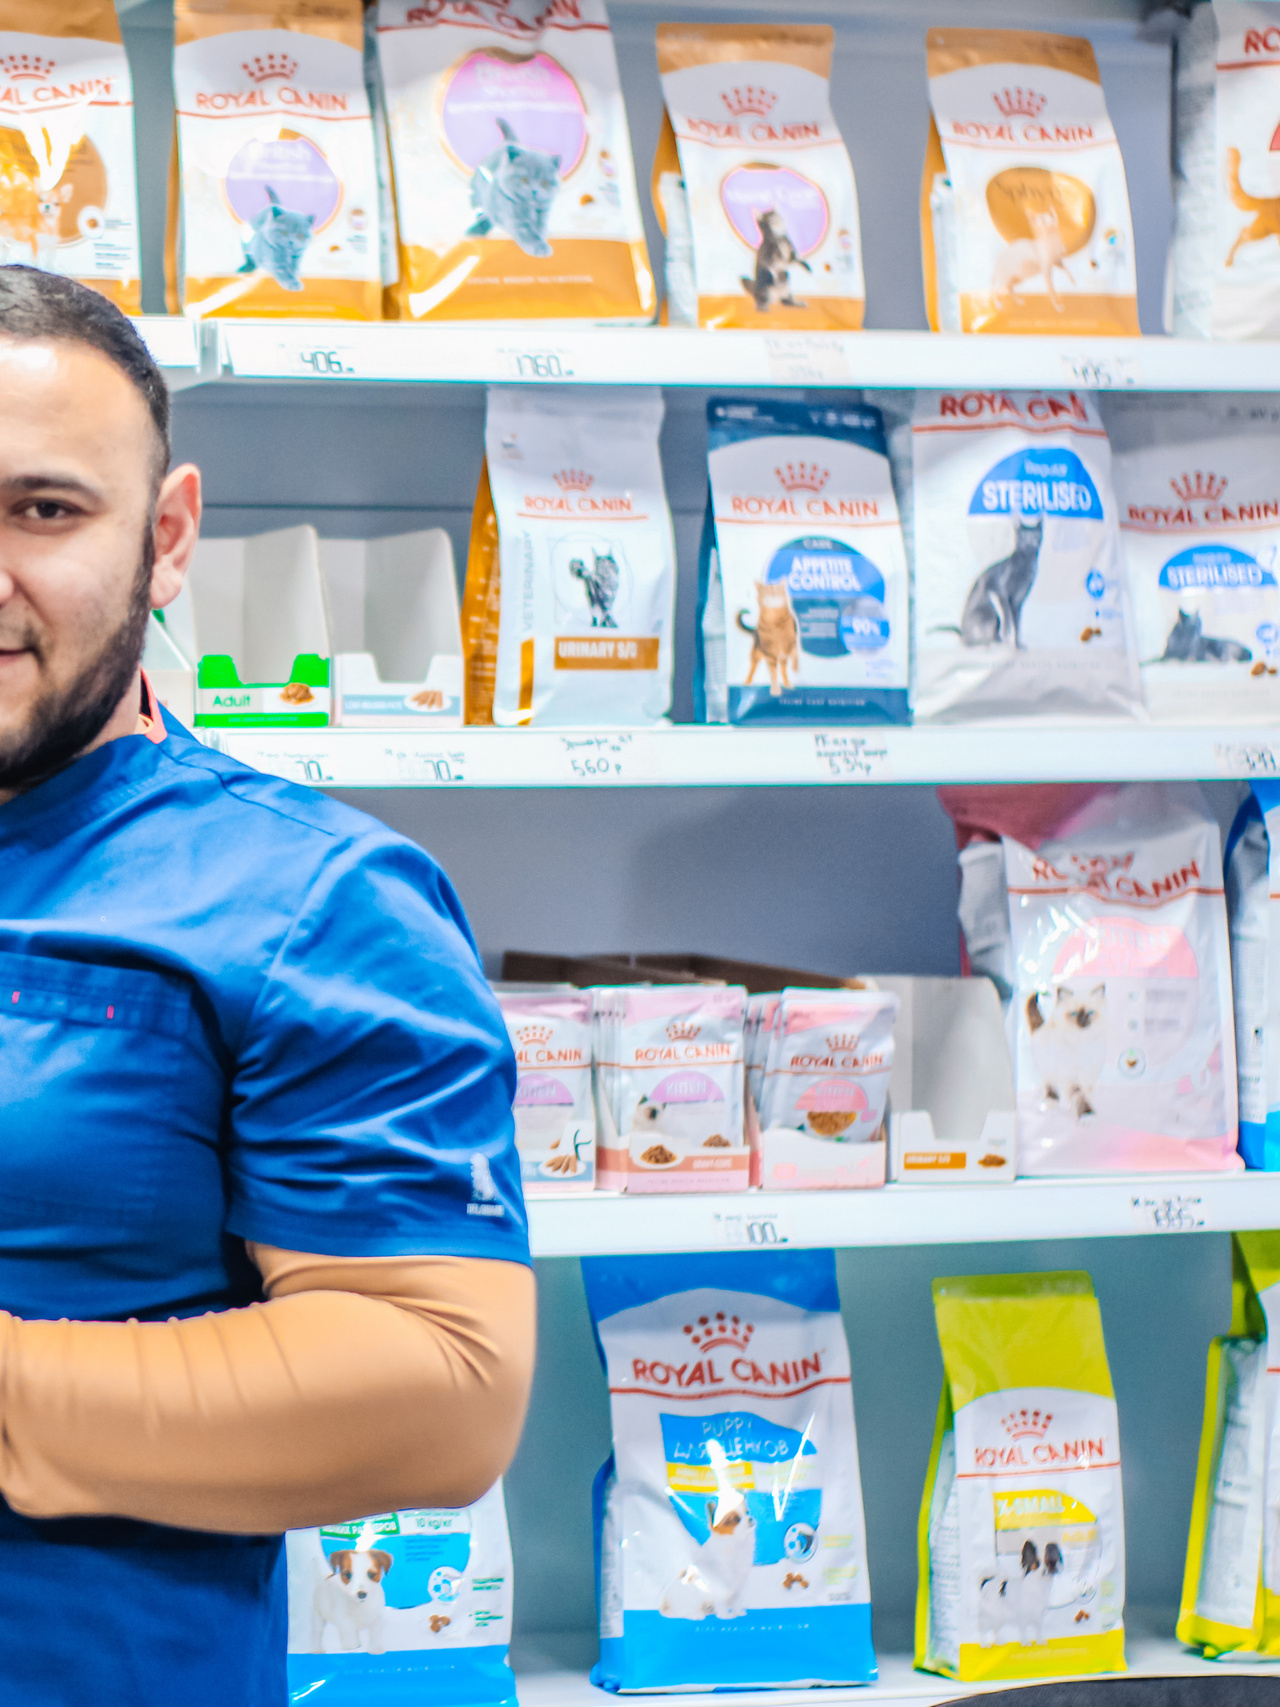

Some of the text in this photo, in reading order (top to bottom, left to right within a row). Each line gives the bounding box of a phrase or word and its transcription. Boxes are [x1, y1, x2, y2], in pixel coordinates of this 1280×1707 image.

[32, 76, 111, 102] CANIN
[195, 86, 347, 111] ROYAL CANIN
[751, 121, 820, 142] CANIN
[952, 120, 1095, 142] ROYAL CANIN
[523, 494, 632, 512] ROYAL CANIN
[732, 496, 879, 517] ROYAL CANIN
[1128, 500, 1279, 524] ROYAL CANIN
[791, 556, 853, 575] APPETITE
[788, 572, 861, 592] CONTROL
[558, 640, 610, 659] URINARY
[212, 694, 252, 708] Adult
[535, 1048, 583, 1063] CANIN
[634, 1044, 731, 1062] ROYAL CANIN
[789, 1054, 835, 1068] ROYAL
[632, 1351, 822, 1388] ROYAL CANIN
[702, 1416, 753, 1438] PUPPY
[1033, 1437, 1106, 1463] CANIN
[415, 1517, 426, 1528] 10
